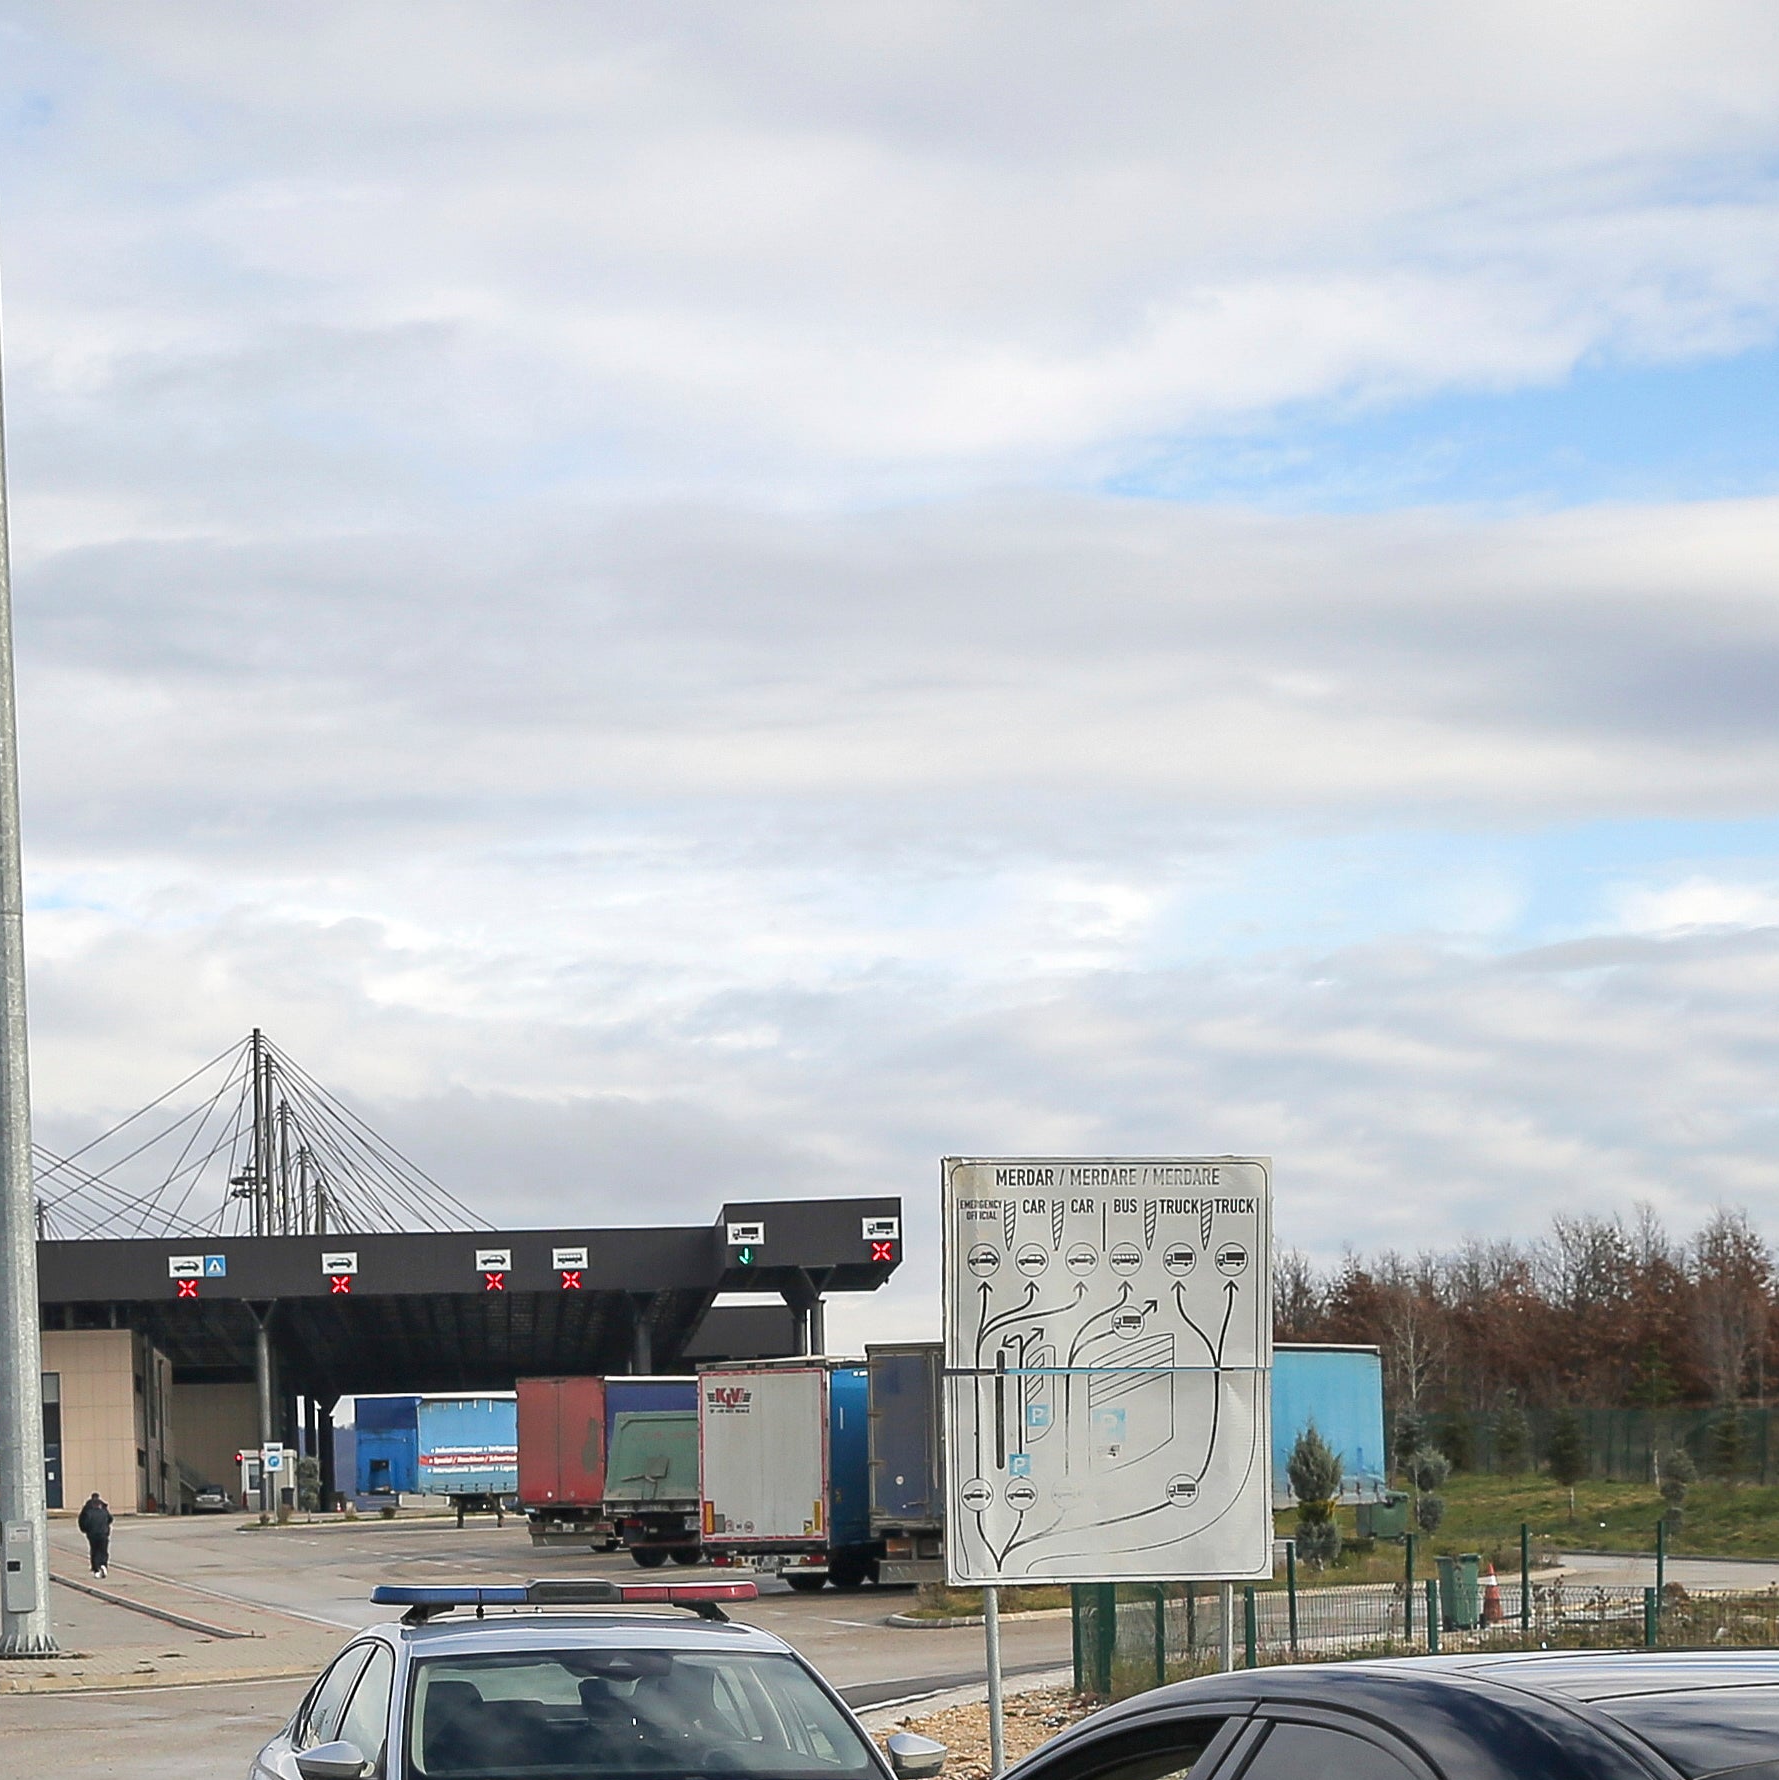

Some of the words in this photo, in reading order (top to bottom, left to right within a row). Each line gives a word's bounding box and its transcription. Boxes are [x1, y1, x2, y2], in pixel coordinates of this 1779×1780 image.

[996, 1168, 1054, 1186] MERDAR
[1070, 1168, 1137, 1186] MERDARE
[1153, 1167, 1220, 1186] MERDARE
[960, 1200, 1002, 1209] EMEGENCY
[1022, 1199, 1046, 1214] CAR
[1071, 1199, 1094, 1213] CAR
[1113, 1198, 1138, 1214] BUS
[1159, 1199, 1199, 1214] TRUCK
[1214, 1198, 1255, 1214] TRUCK
[1031, 1408, 1044, 1424] P
[1014, 1457, 1026, 1473] P
